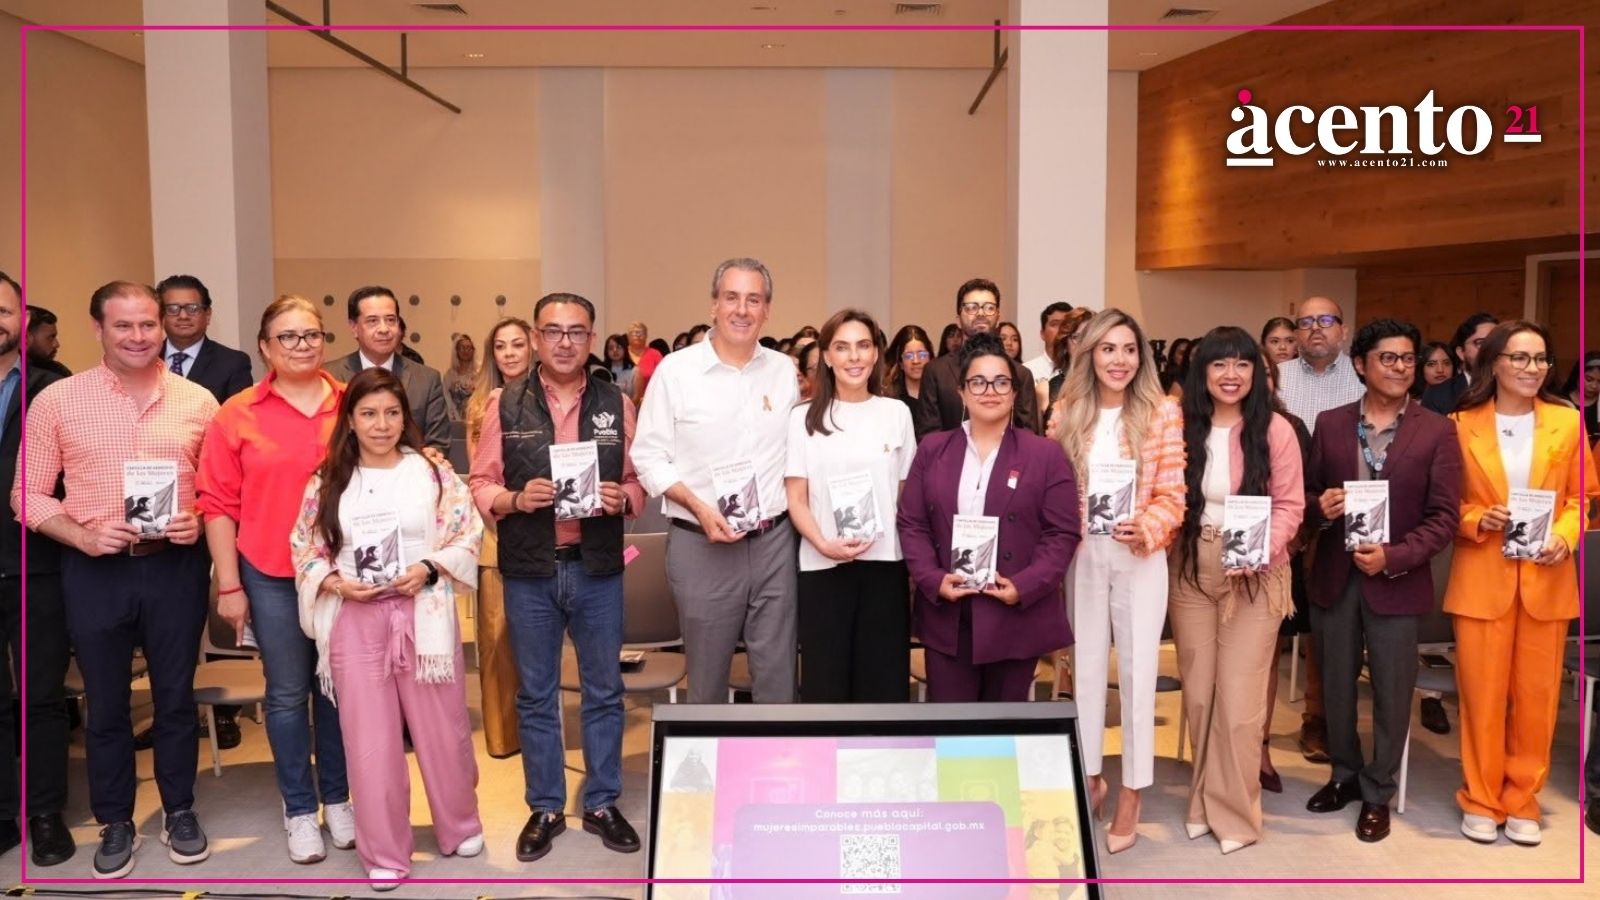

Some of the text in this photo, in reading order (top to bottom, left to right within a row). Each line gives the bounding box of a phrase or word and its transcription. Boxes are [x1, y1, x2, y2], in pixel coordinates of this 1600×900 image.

[815, 807, 924, 819] Conoce más aquí:
